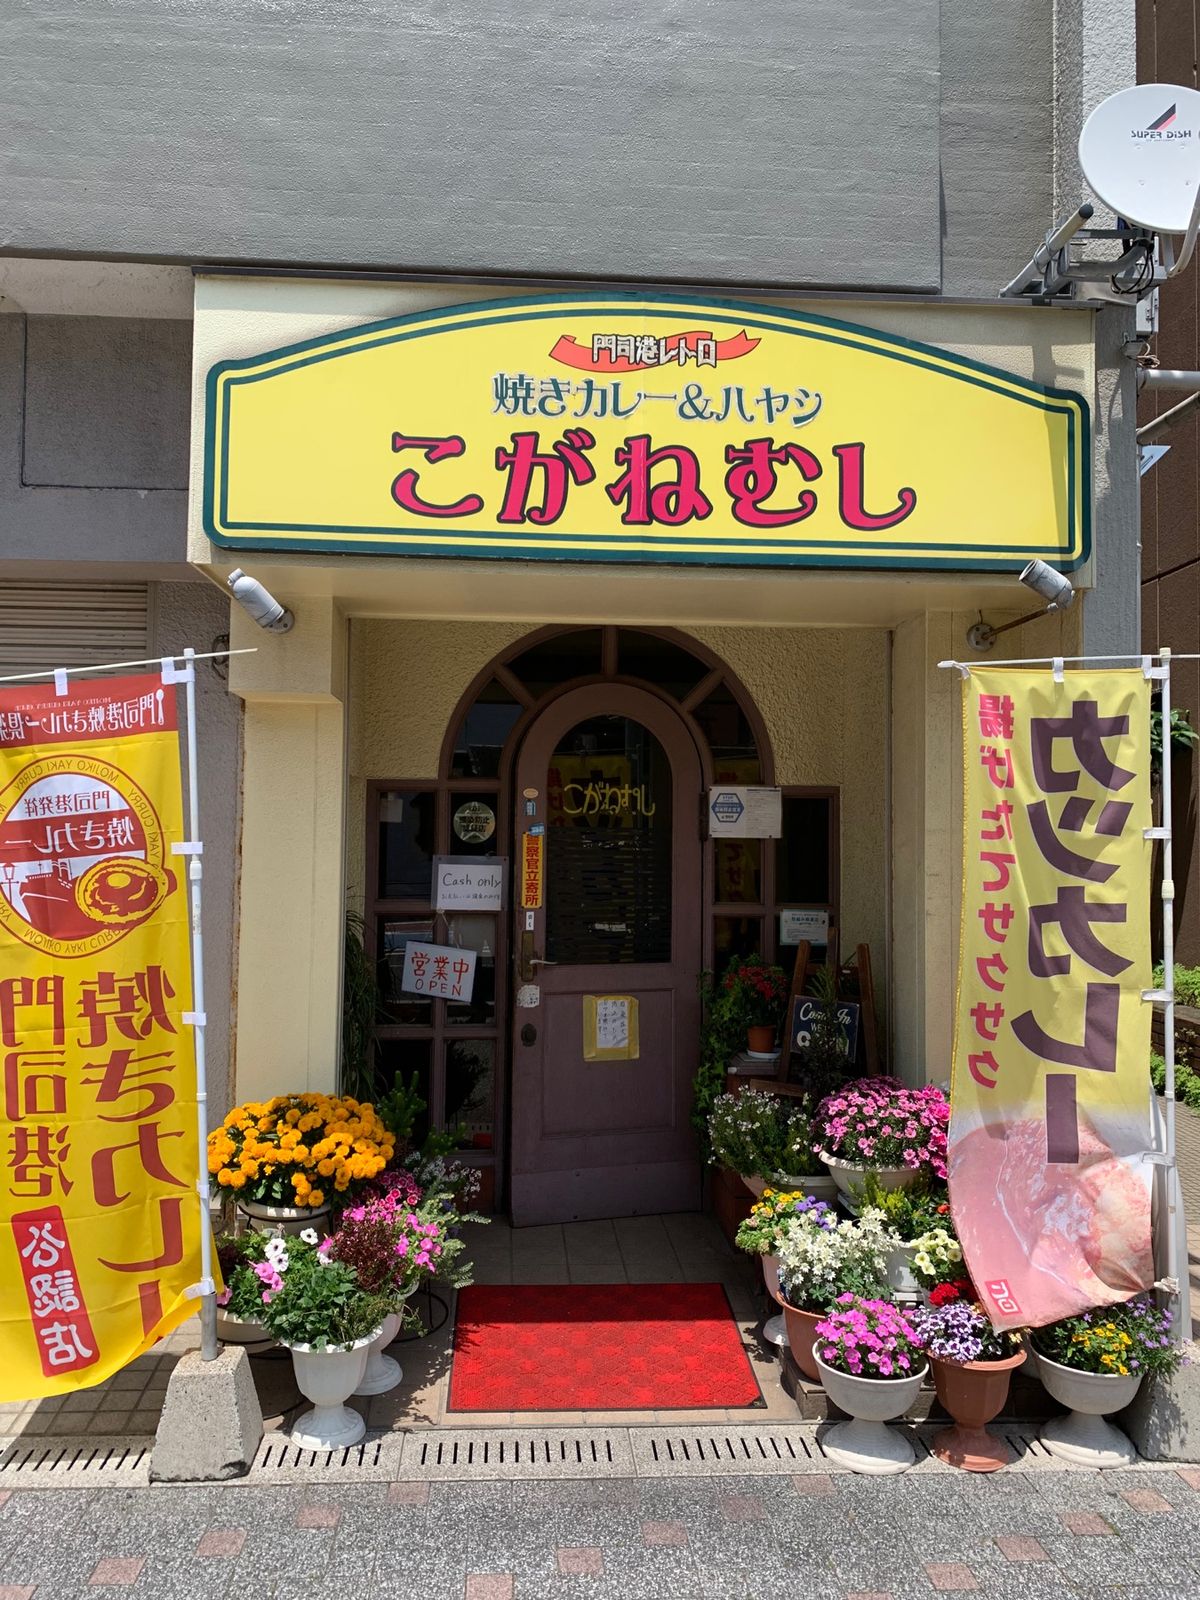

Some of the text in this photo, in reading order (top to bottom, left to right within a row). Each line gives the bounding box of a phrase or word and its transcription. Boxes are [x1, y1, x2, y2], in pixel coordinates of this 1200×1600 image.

[1131, 130, 1162, 139] SUPER
[592, 334, 717, 368] 門司港レトロ
[493, 373, 823, 426] 焼きカレー&ハヤシ
[391, 429, 918, 532] こがねむし
[562, 781, 656, 816] こがねむし
[442, 872, 472, 887] Cash
[411, 951, 469, 984] 営業中
[415, 978, 462, 996] OPEN
